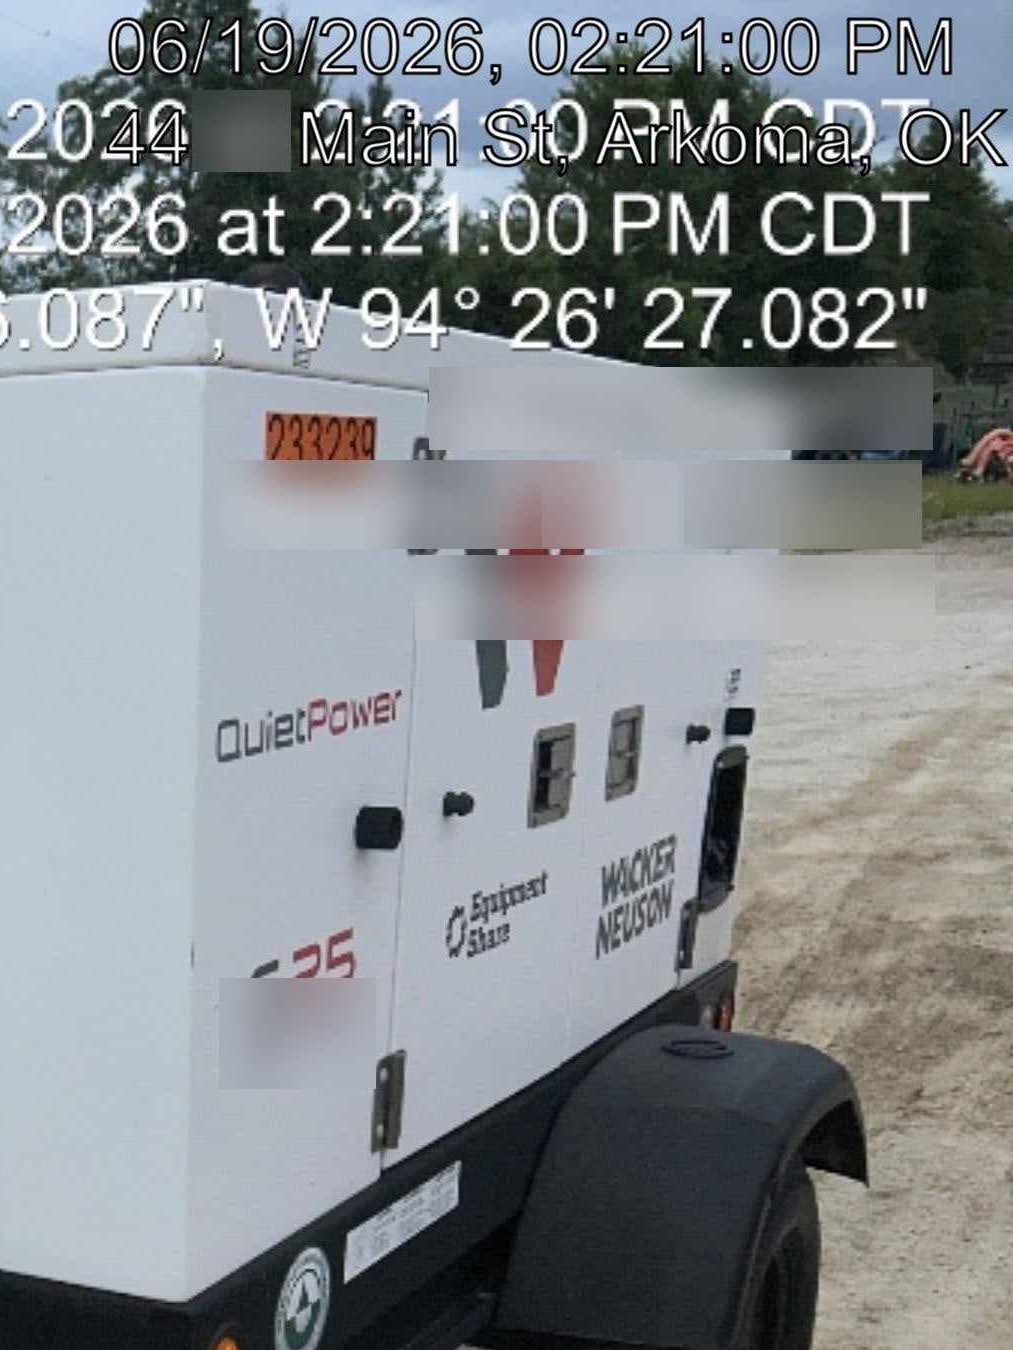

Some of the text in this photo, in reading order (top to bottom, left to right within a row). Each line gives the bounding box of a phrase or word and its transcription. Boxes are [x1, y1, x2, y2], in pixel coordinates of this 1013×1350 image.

[216, 689, 403, 763] QuietPower
[601, 834, 677, 908] WACKER
[595, 878, 675, 960] NEUSON
